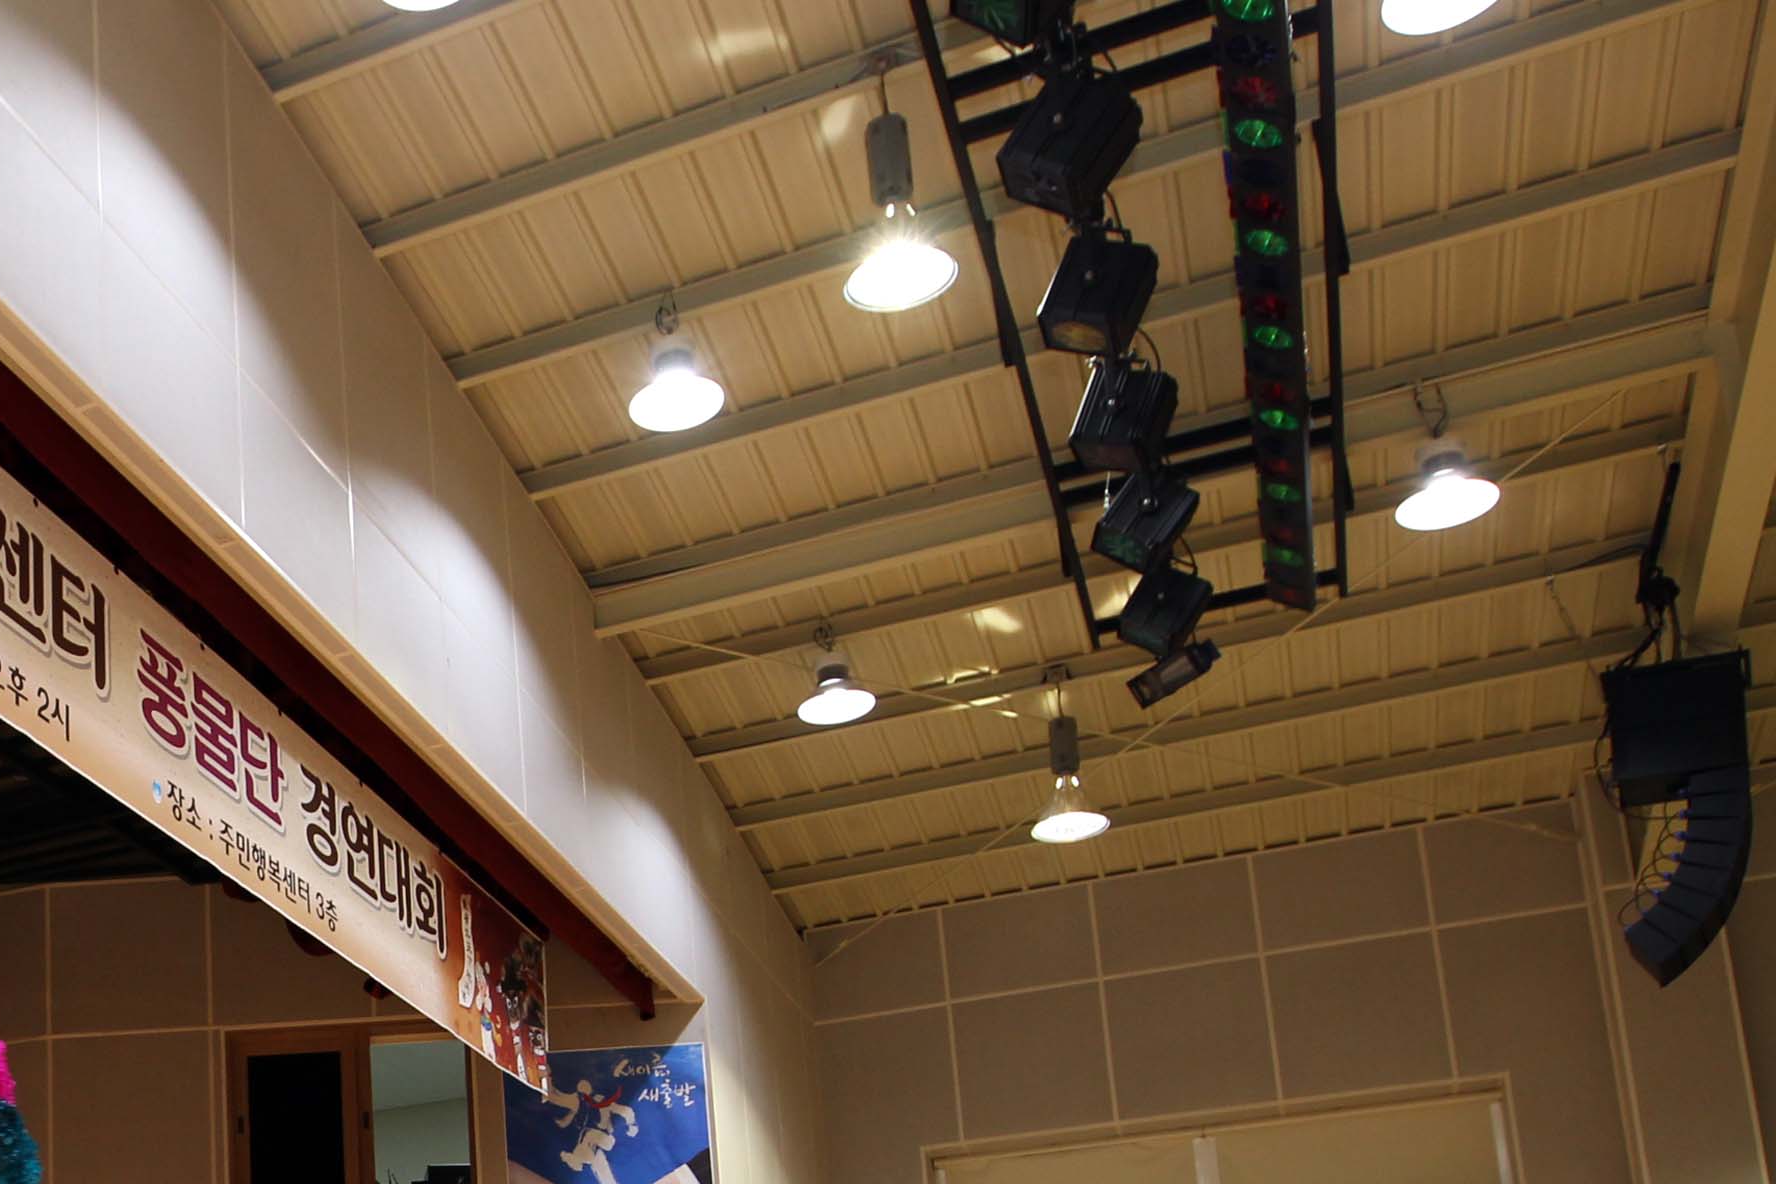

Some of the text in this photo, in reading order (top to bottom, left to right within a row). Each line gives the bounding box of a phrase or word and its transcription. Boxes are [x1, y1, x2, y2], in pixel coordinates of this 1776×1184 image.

[36, 687, 71, 742] 2시
[136, 626, 286, 827] 풍물단
[300, 763, 445, 954] 경연대회
[167, 780, 203, 832] 장소
[218, 818, 312, 914] 주민행복센터
[316, 891, 339, 933] 3층
[638, 1078, 697, 1110] 새출발
